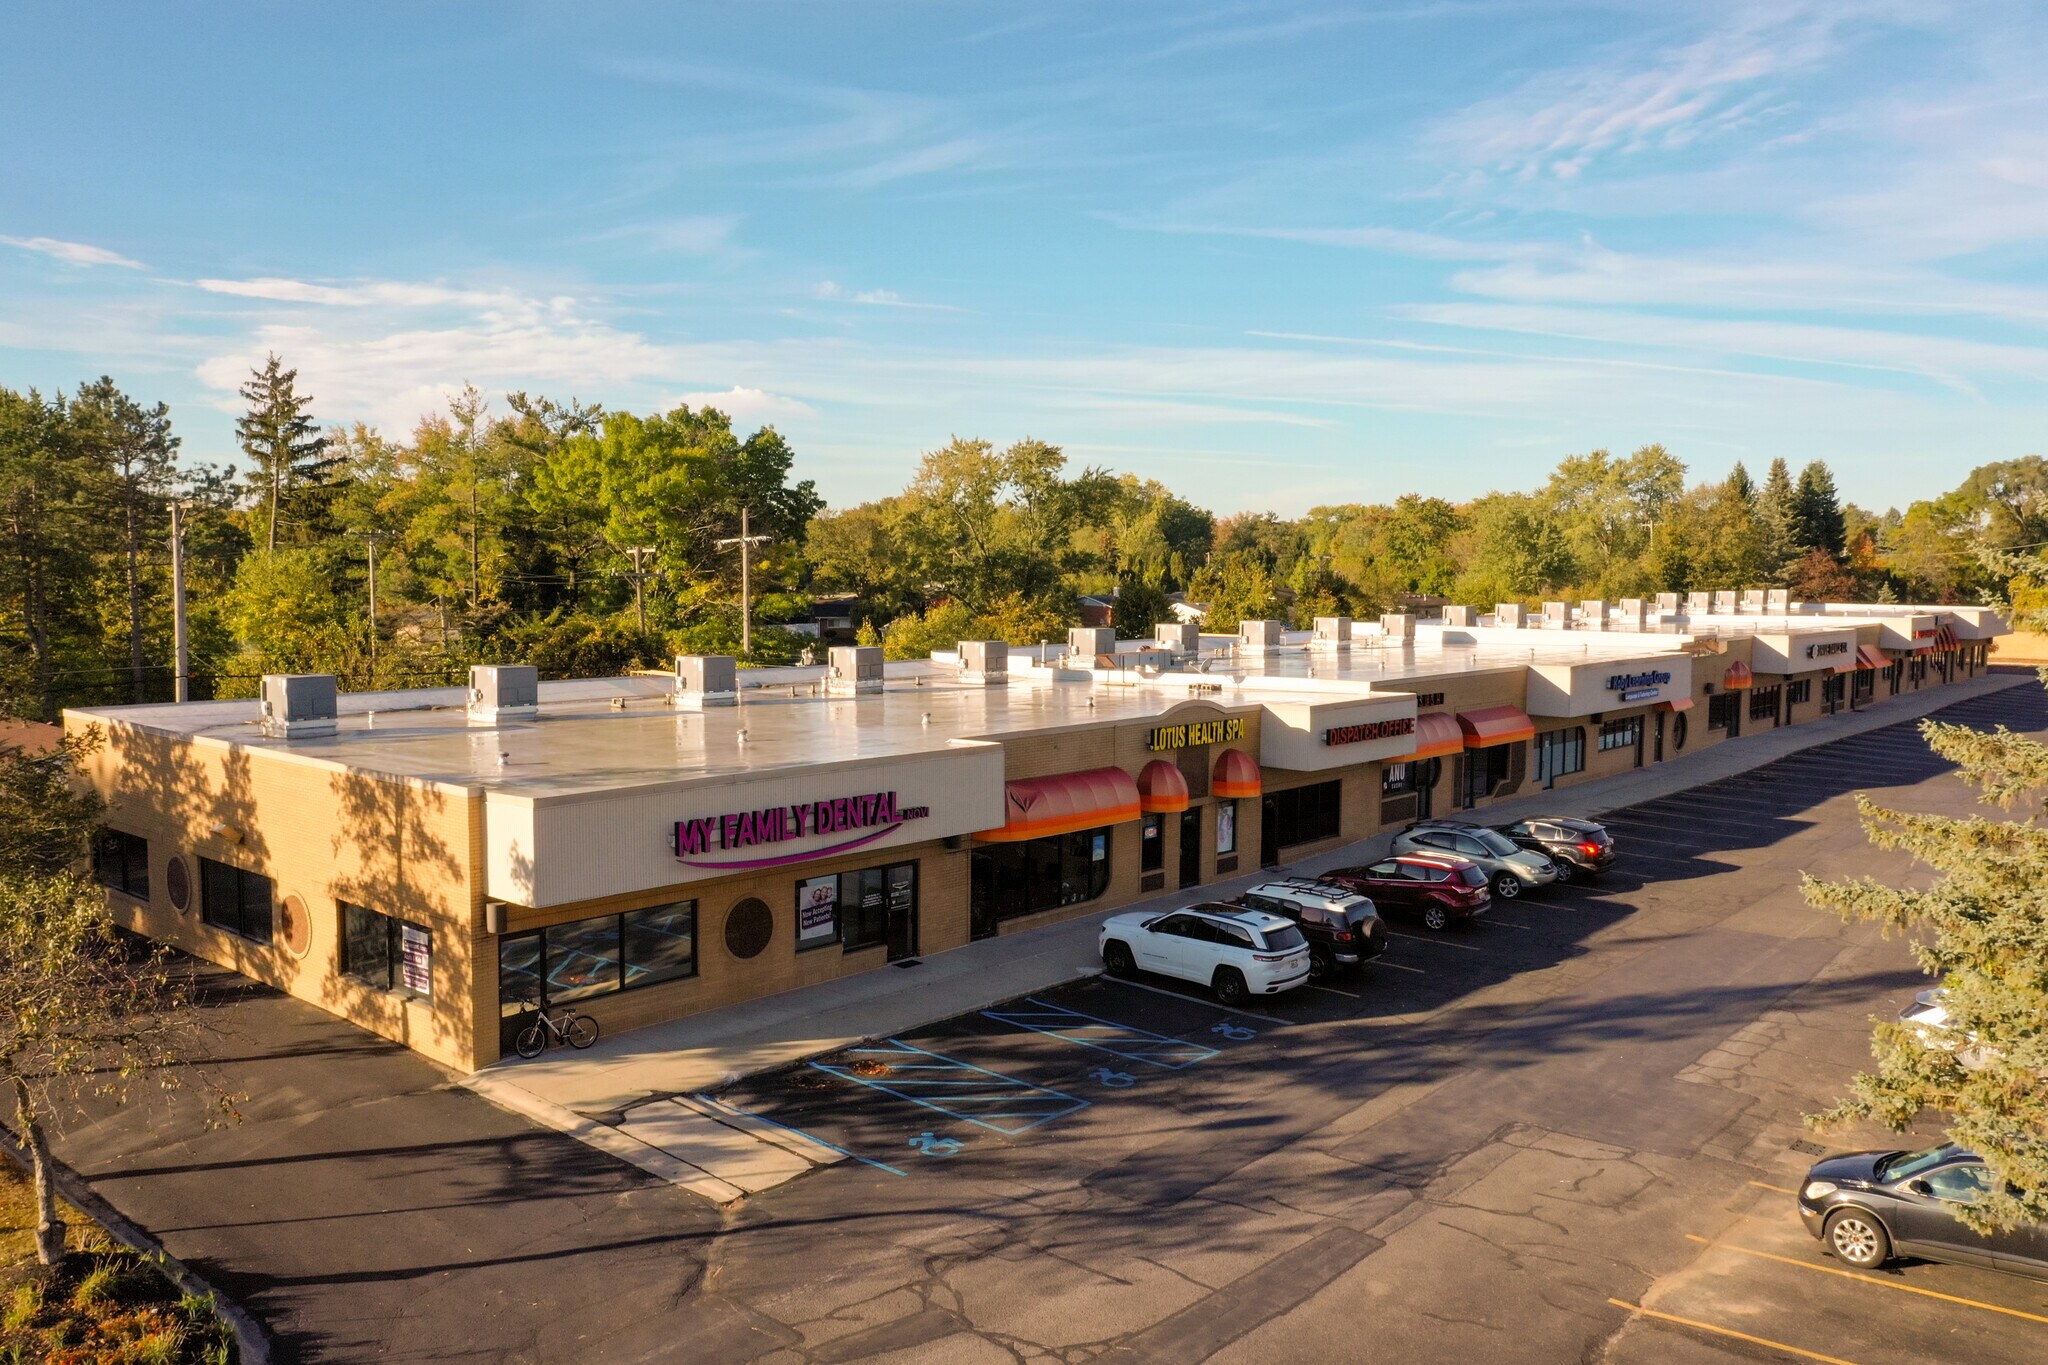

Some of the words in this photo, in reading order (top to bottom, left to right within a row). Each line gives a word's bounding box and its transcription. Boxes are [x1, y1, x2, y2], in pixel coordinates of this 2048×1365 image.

[1627, 672, 1653, 688] Learning
[1652, 670, 1671, 684] Group
[1151, 725, 1185, 751] LOTUS
[1186, 720, 1224, 746] HEALTH
[1225, 718, 1244, 741] SPA
[1326, 723, 1379, 746] DISPATCH
[1379, 718, 1415, 737] OFFICE
[1389, 763, 1405, 782] ANU
[675, 817, 716, 857] MY
[720, 804, 811, 850] FAMILY
[814, 791, 904, 835] DENTAL
[904, 806, 930, 820] NOVI
[802, 911, 812, 919] Now
[812, 903, 833, 916] Accepting
[802, 918, 813, 927] New
